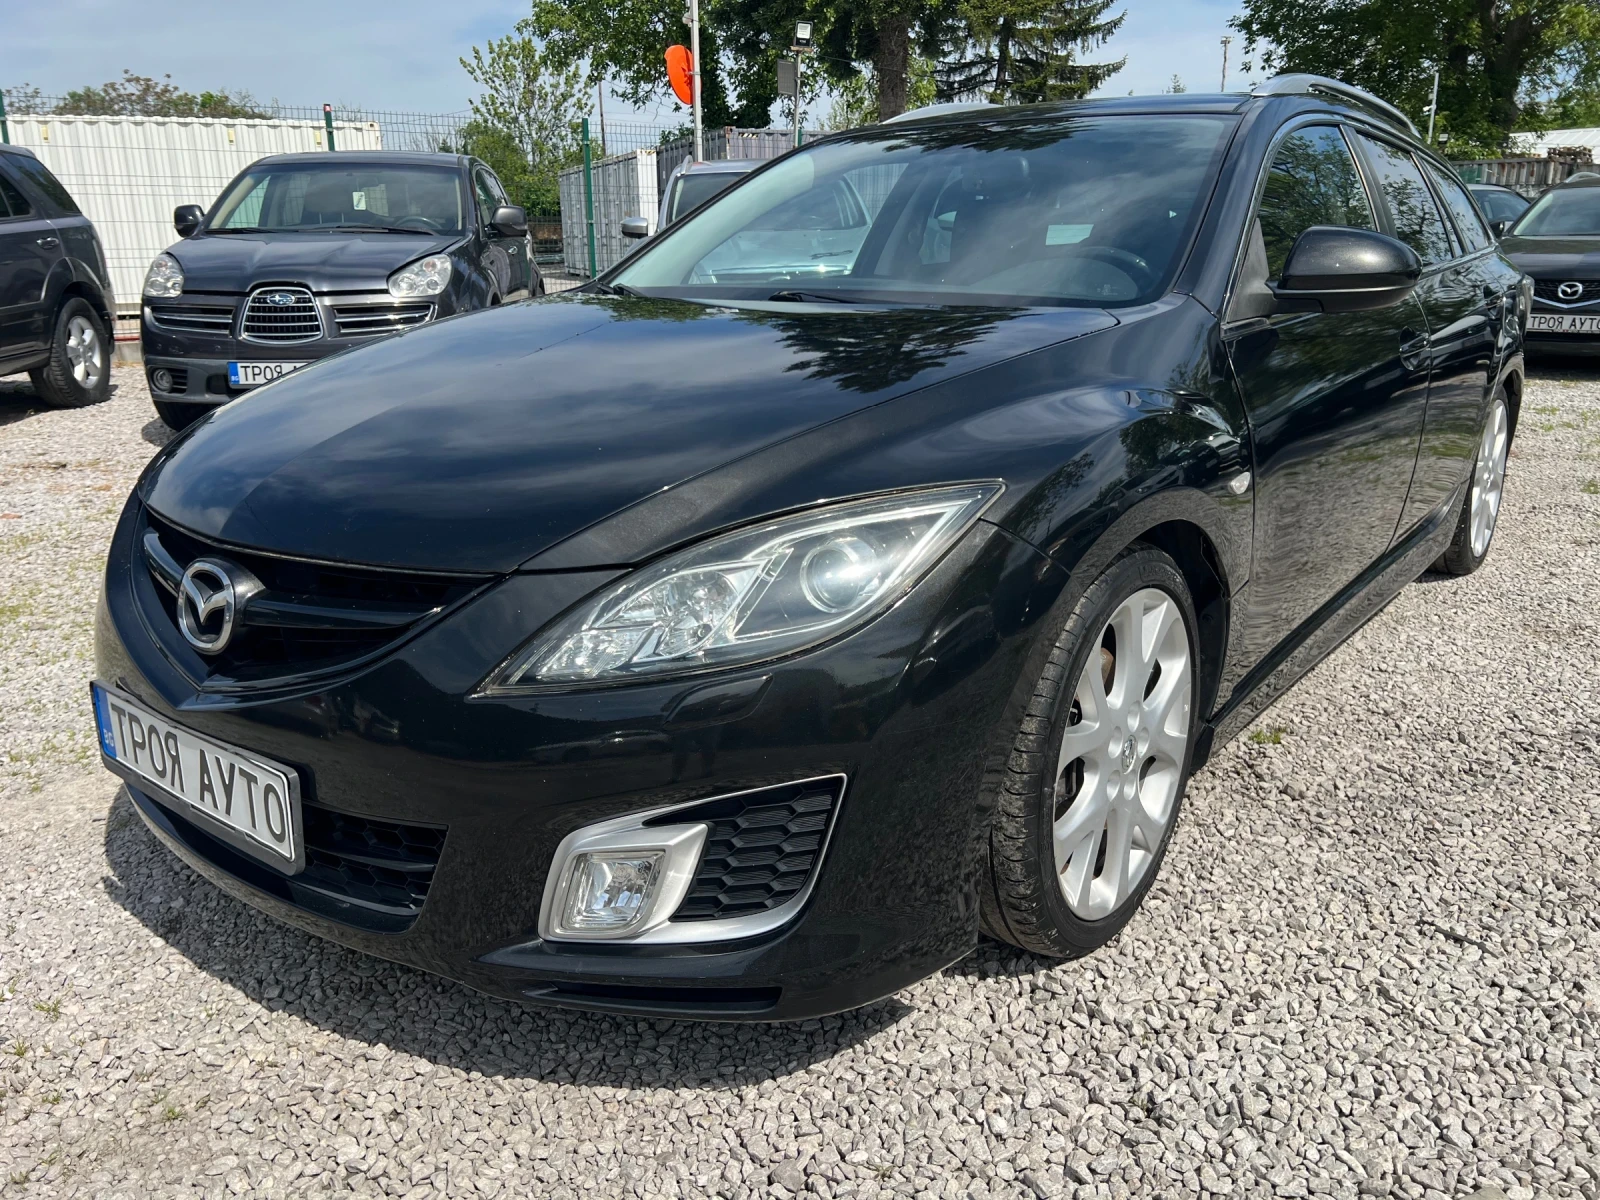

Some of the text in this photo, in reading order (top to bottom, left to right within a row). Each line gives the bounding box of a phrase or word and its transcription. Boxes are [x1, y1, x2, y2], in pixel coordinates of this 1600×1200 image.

[1530, 316, 1564, 328] ТРОЯ
[240, 364, 283, 382] ТРОЯ
[103, 728, 114, 747] BG
[110, 702, 286, 844] ТРОЯ АУТО
